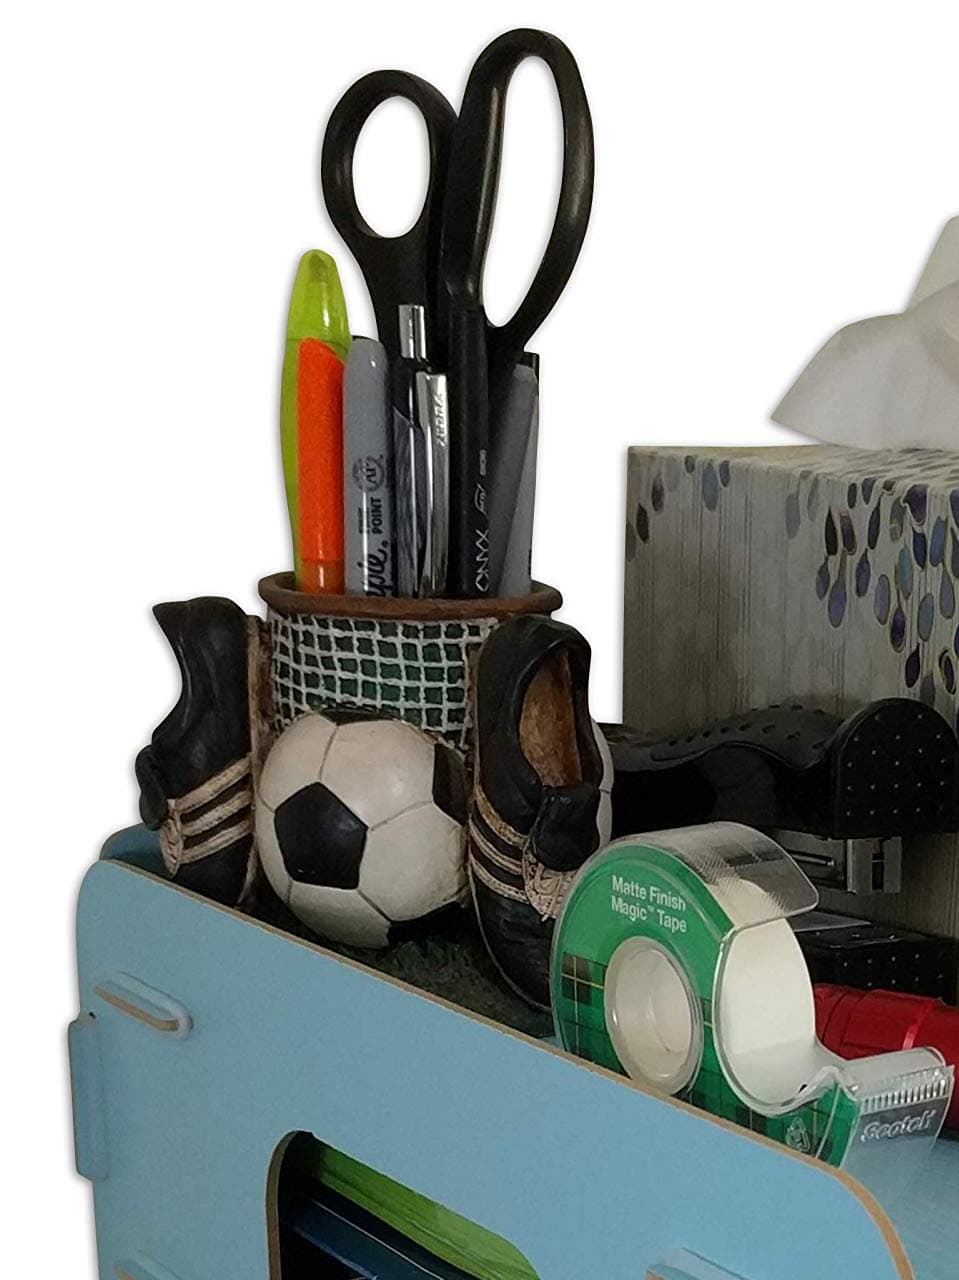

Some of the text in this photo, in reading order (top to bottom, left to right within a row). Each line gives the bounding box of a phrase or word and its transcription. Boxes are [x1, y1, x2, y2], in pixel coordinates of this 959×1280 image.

[371, 497, 383, 535] POINT
[612, 875, 686, 912] Matte Finish
[656, 911, 687, 933] Tape
[863, 1109, 937, 1140] Scotch
